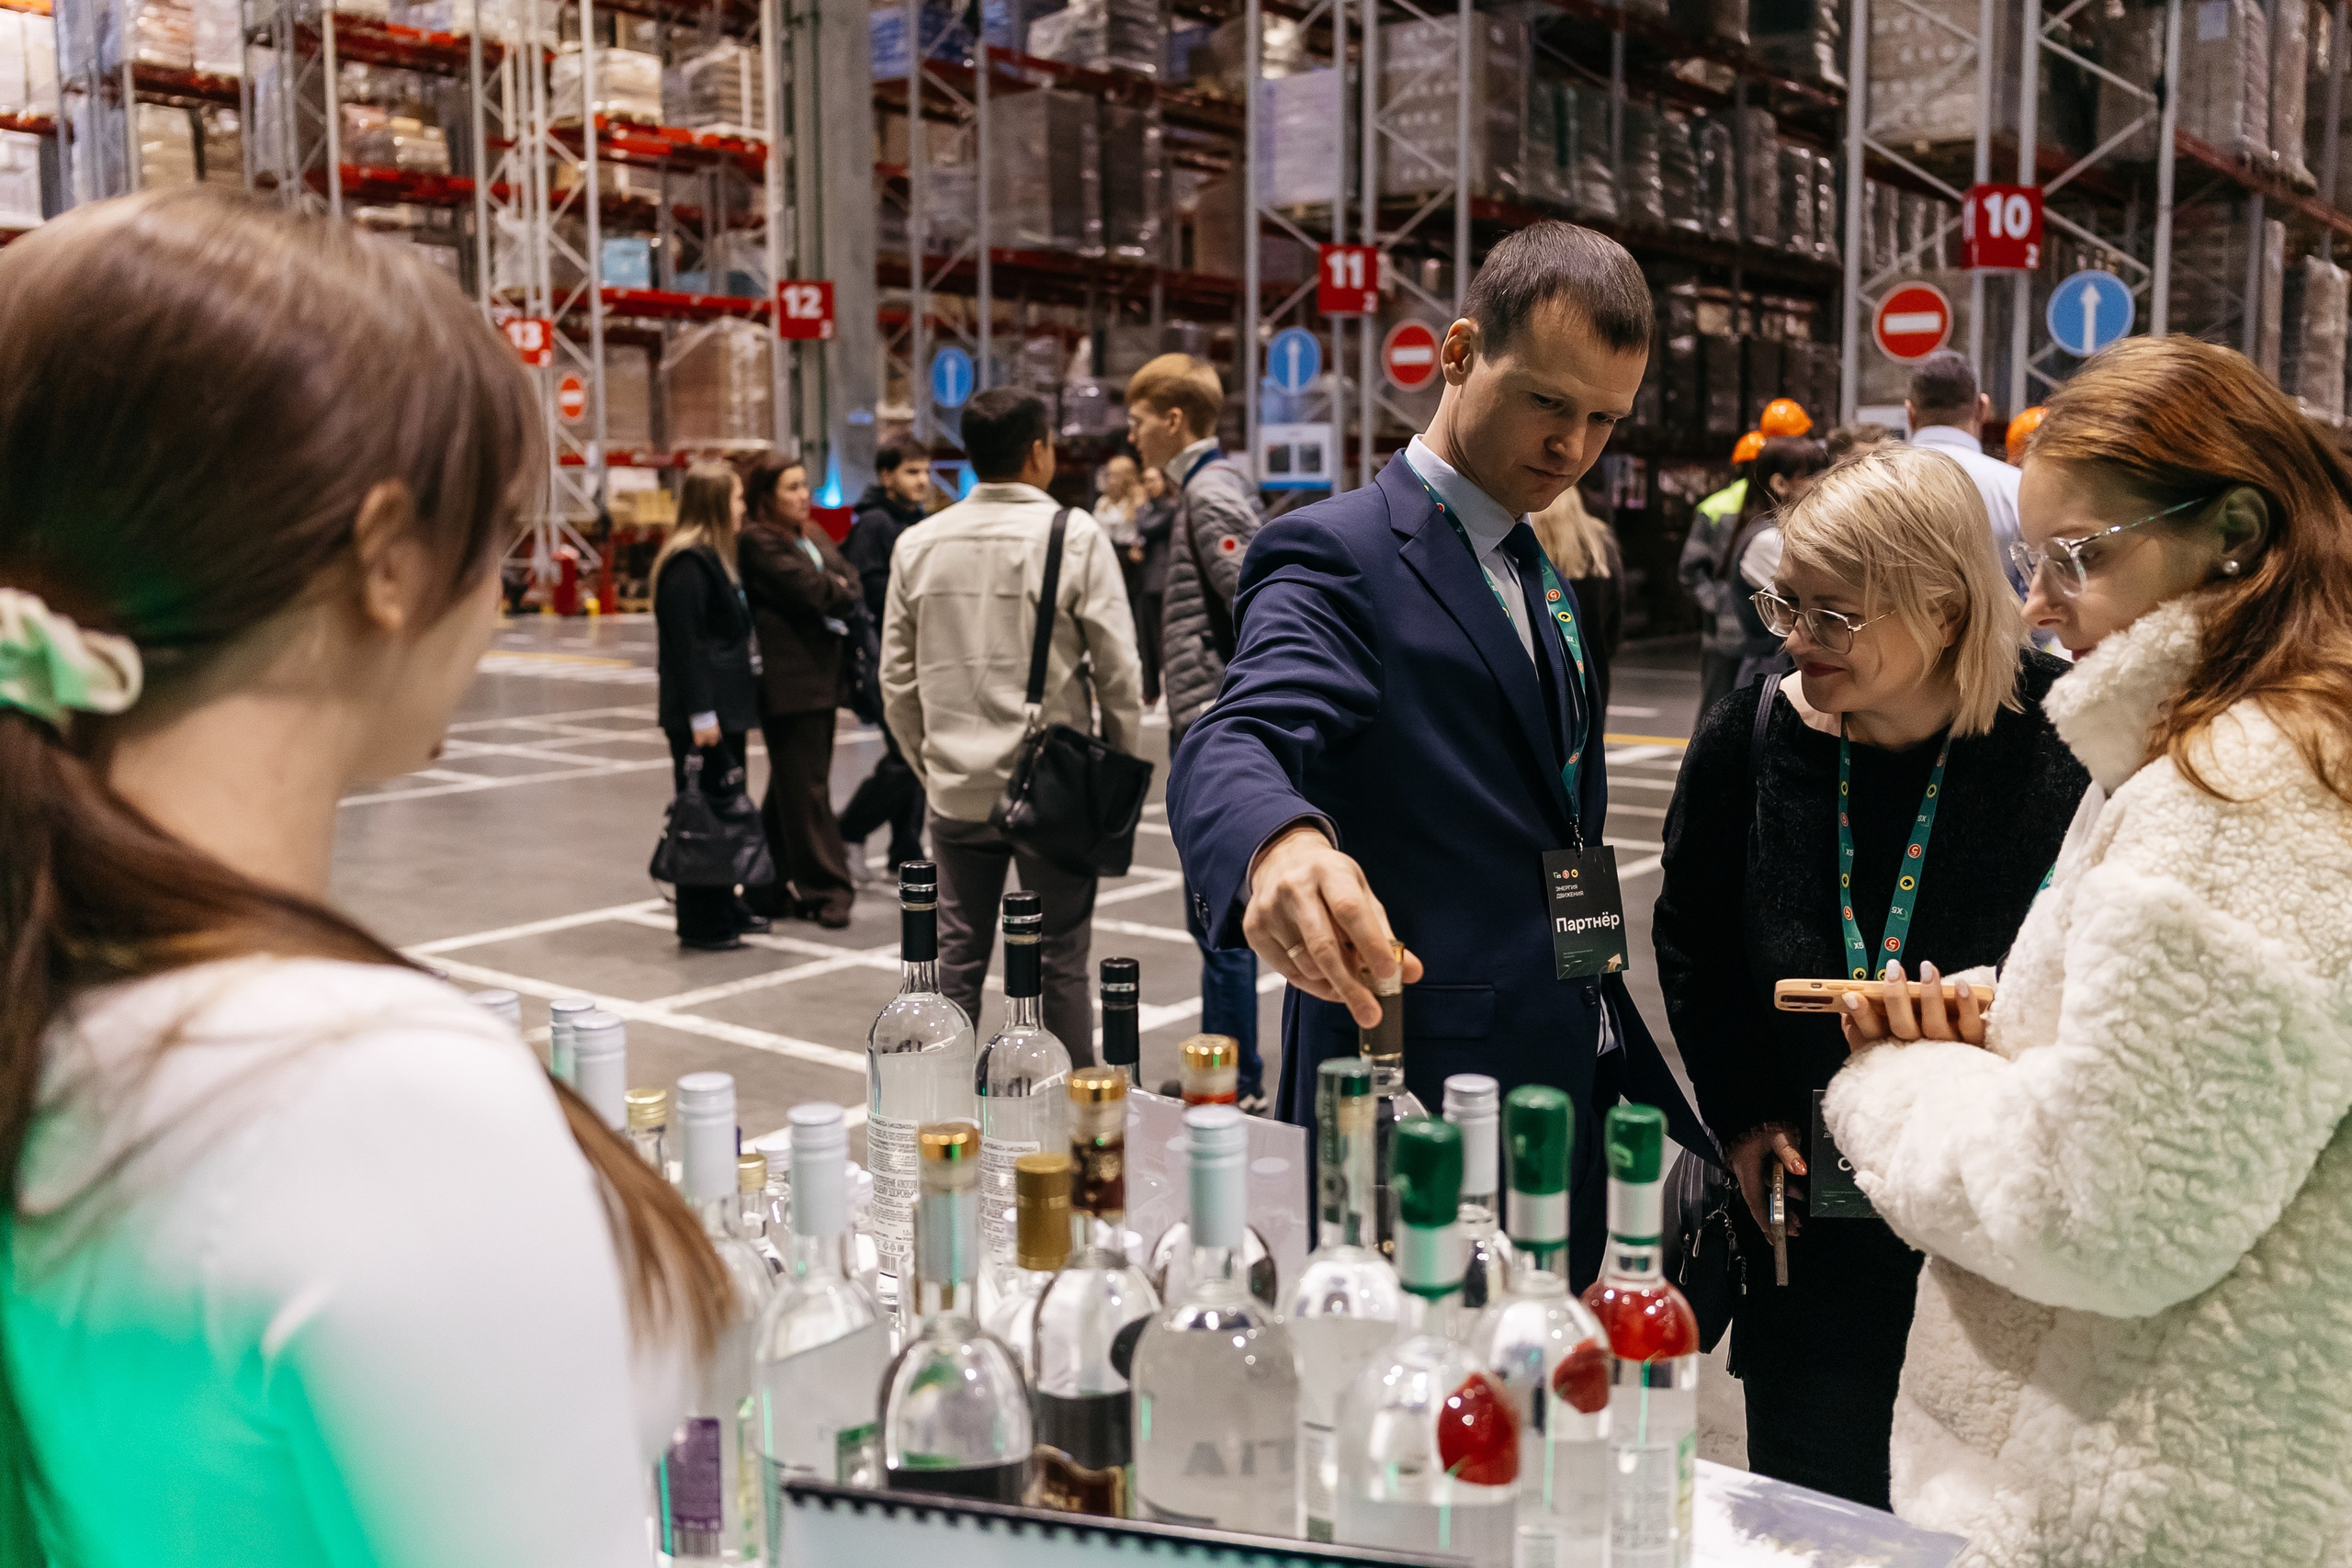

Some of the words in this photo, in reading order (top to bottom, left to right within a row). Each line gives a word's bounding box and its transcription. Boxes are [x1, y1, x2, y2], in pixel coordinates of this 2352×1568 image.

[1983, 191, 2032, 240] 10
[1326, 251, 1364, 289] 11
[781, 285, 823, 319] 12
[507, 321, 543, 350] 13
[1555, 911, 1620, 934] Партнёр
[1891, 906, 1904, 915] X5
